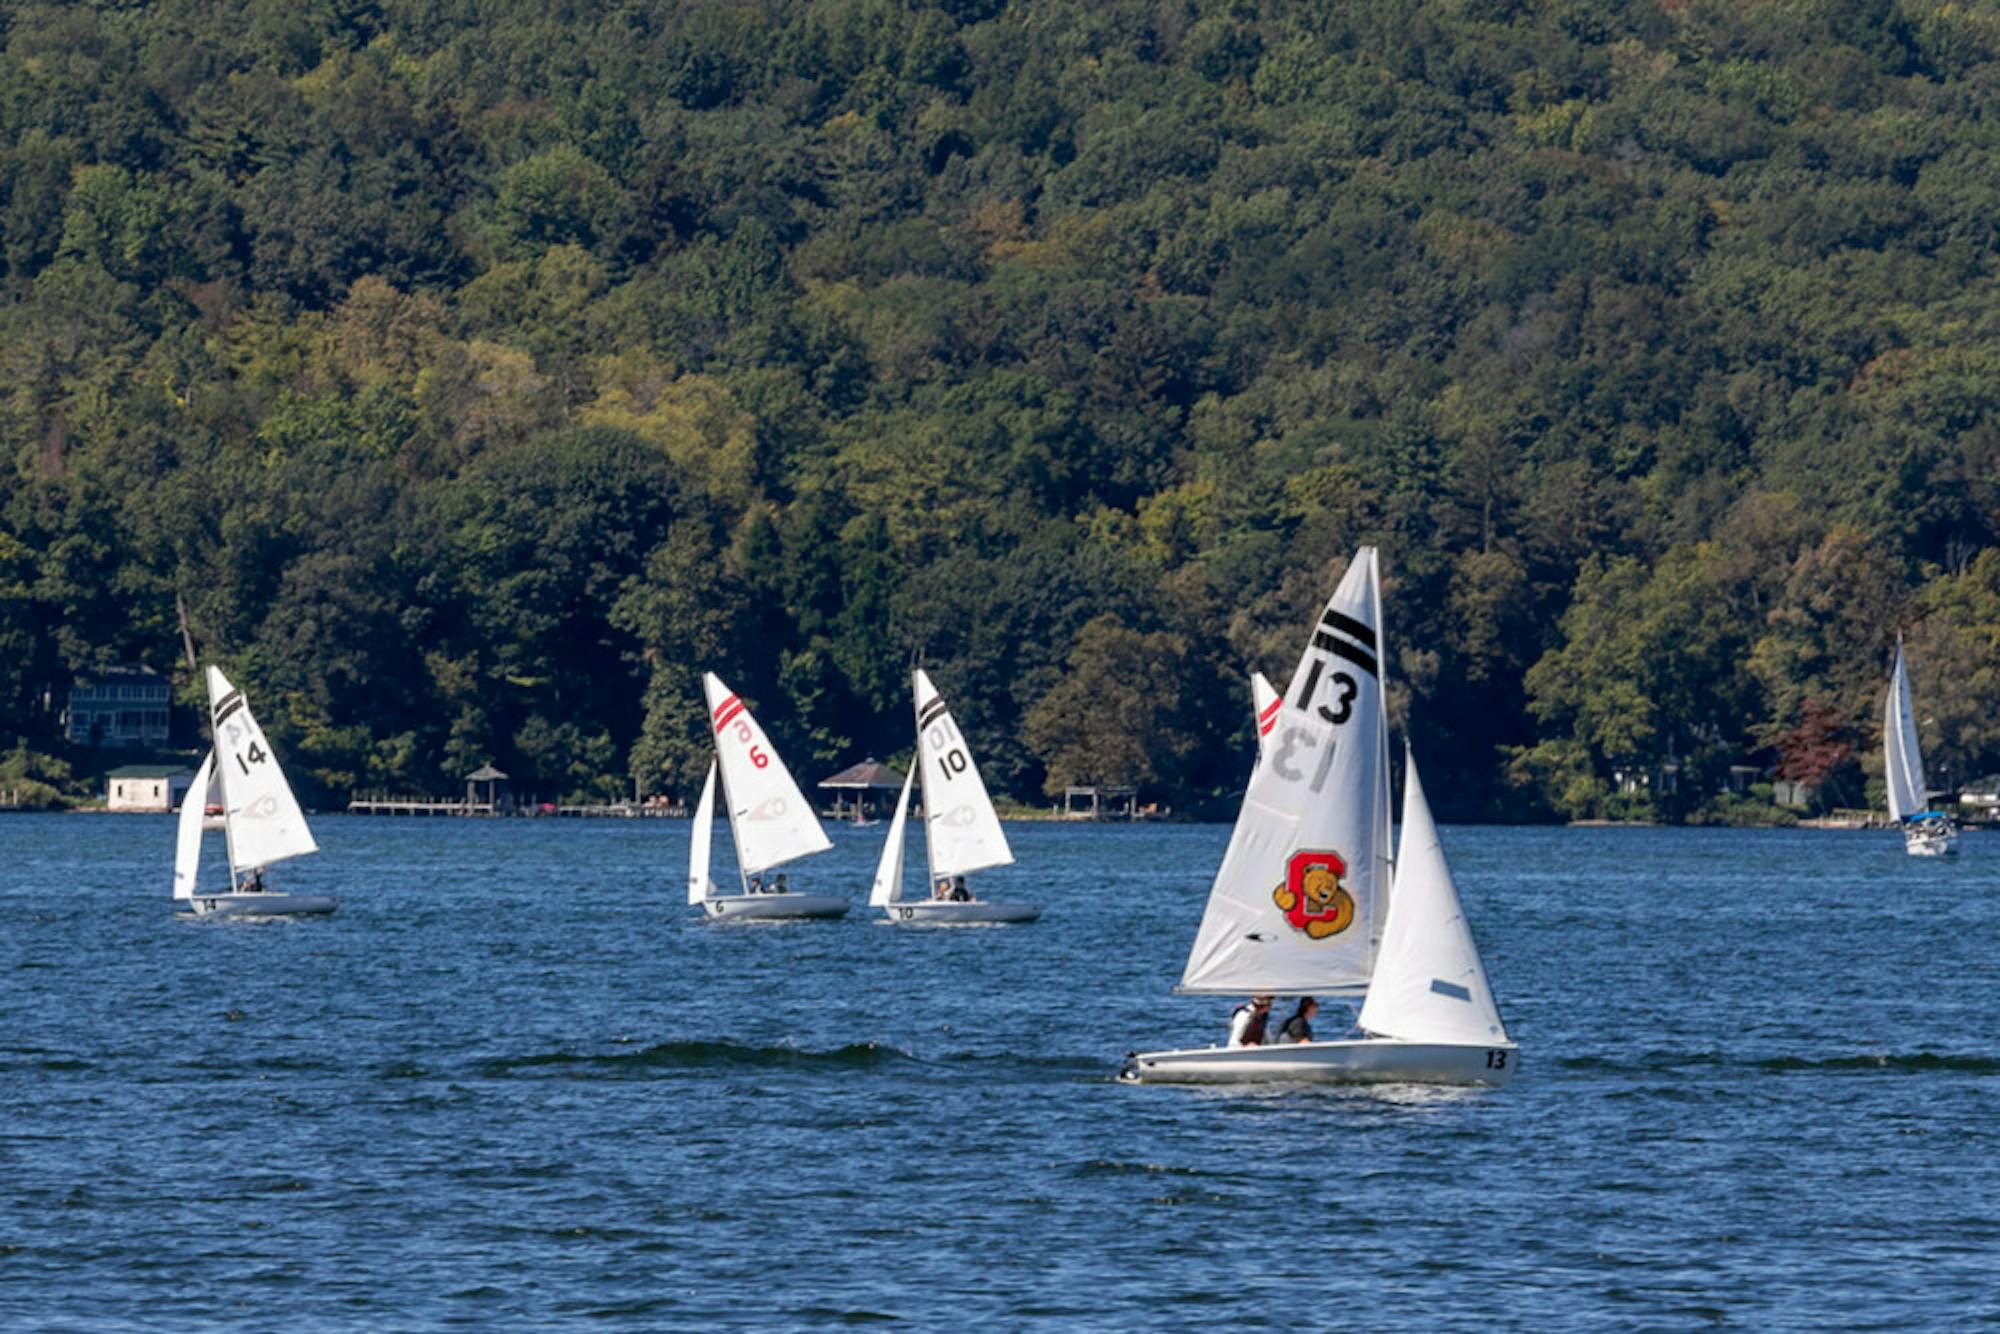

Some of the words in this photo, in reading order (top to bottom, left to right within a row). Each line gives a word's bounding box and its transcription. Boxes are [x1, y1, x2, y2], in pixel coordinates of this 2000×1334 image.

[1296, 658, 1358, 725] 13
[236, 740, 267, 776] 14
[750, 745, 769, 769] 6
[938, 748, 967, 781] 10
[202, 899, 217, 912] 14
[715, 901, 725, 913] 6
[898, 907, 914, 920] 10
[1487, 1050, 1507, 1070] 13
